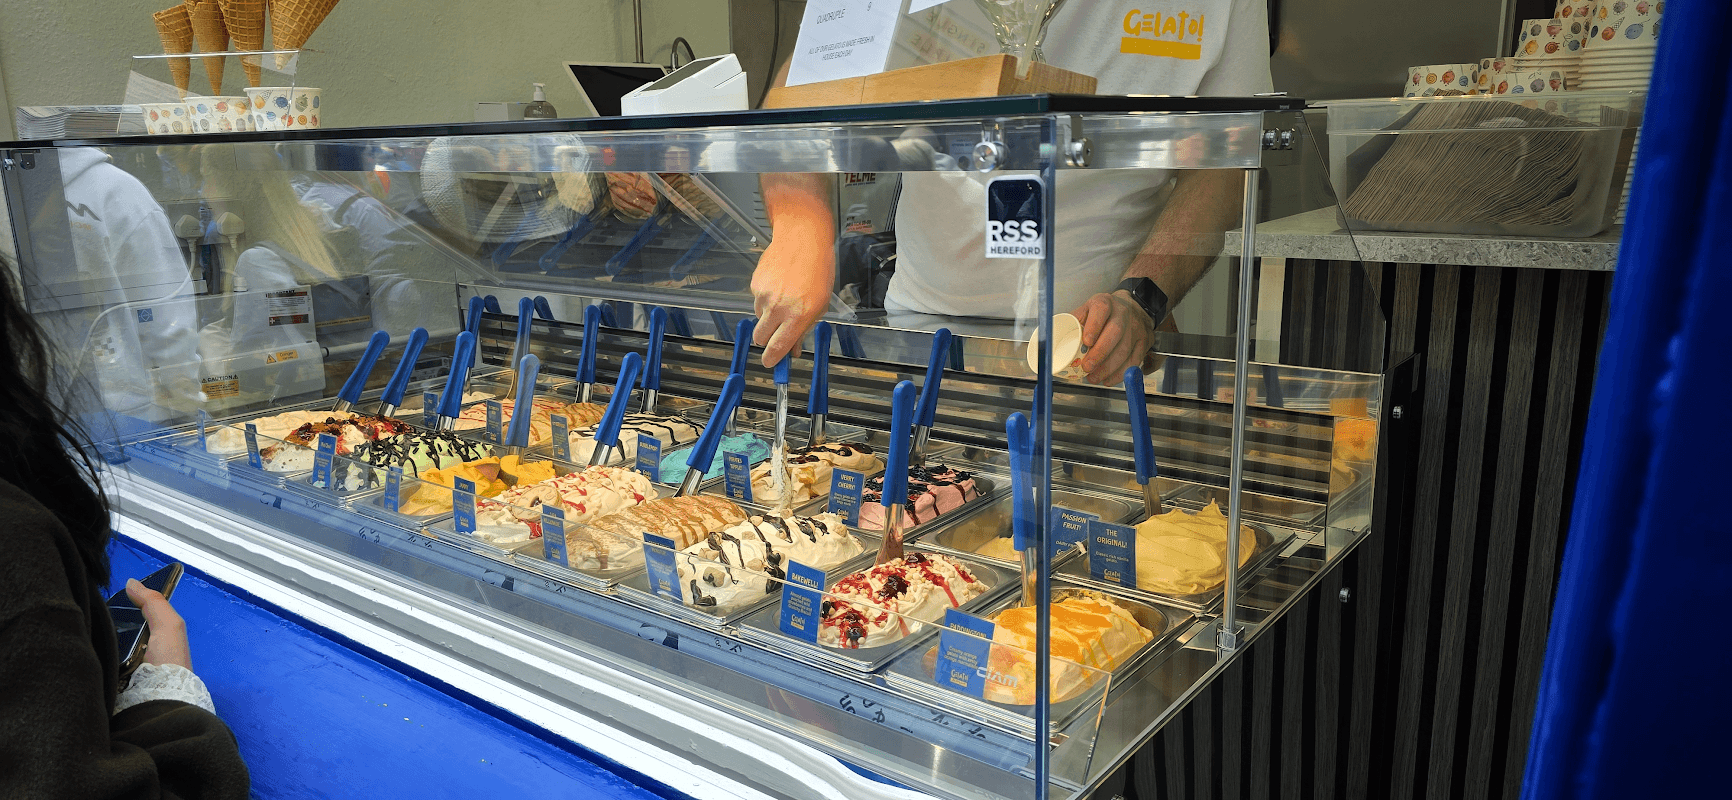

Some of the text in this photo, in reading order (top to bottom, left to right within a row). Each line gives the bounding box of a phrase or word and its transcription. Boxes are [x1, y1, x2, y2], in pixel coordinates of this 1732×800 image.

[816, 8, 846, 25] QUADRUPLE
[827, 42, 841, 51] GELATO
[845, 39, 857, 47] MADE
[856, 37, 870, 45] FRESH
[821, 49, 854, 61] HOUSE EACH DAY
[844, 172, 876, 184] TELME
[987, 219, 1038, 242] RSS
[990, 246, 1041, 255] HEREFORD
[841, 474, 855, 482] VERRY
[1061, 512, 1087, 524] PASSION
[1062, 521, 1082, 531] FRUIT!
[1105, 528, 1118, 537] THE
[1096, 536, 1128, 549] ORIGINAL!
[791, 572, 819, 588] BAKEWELL!
